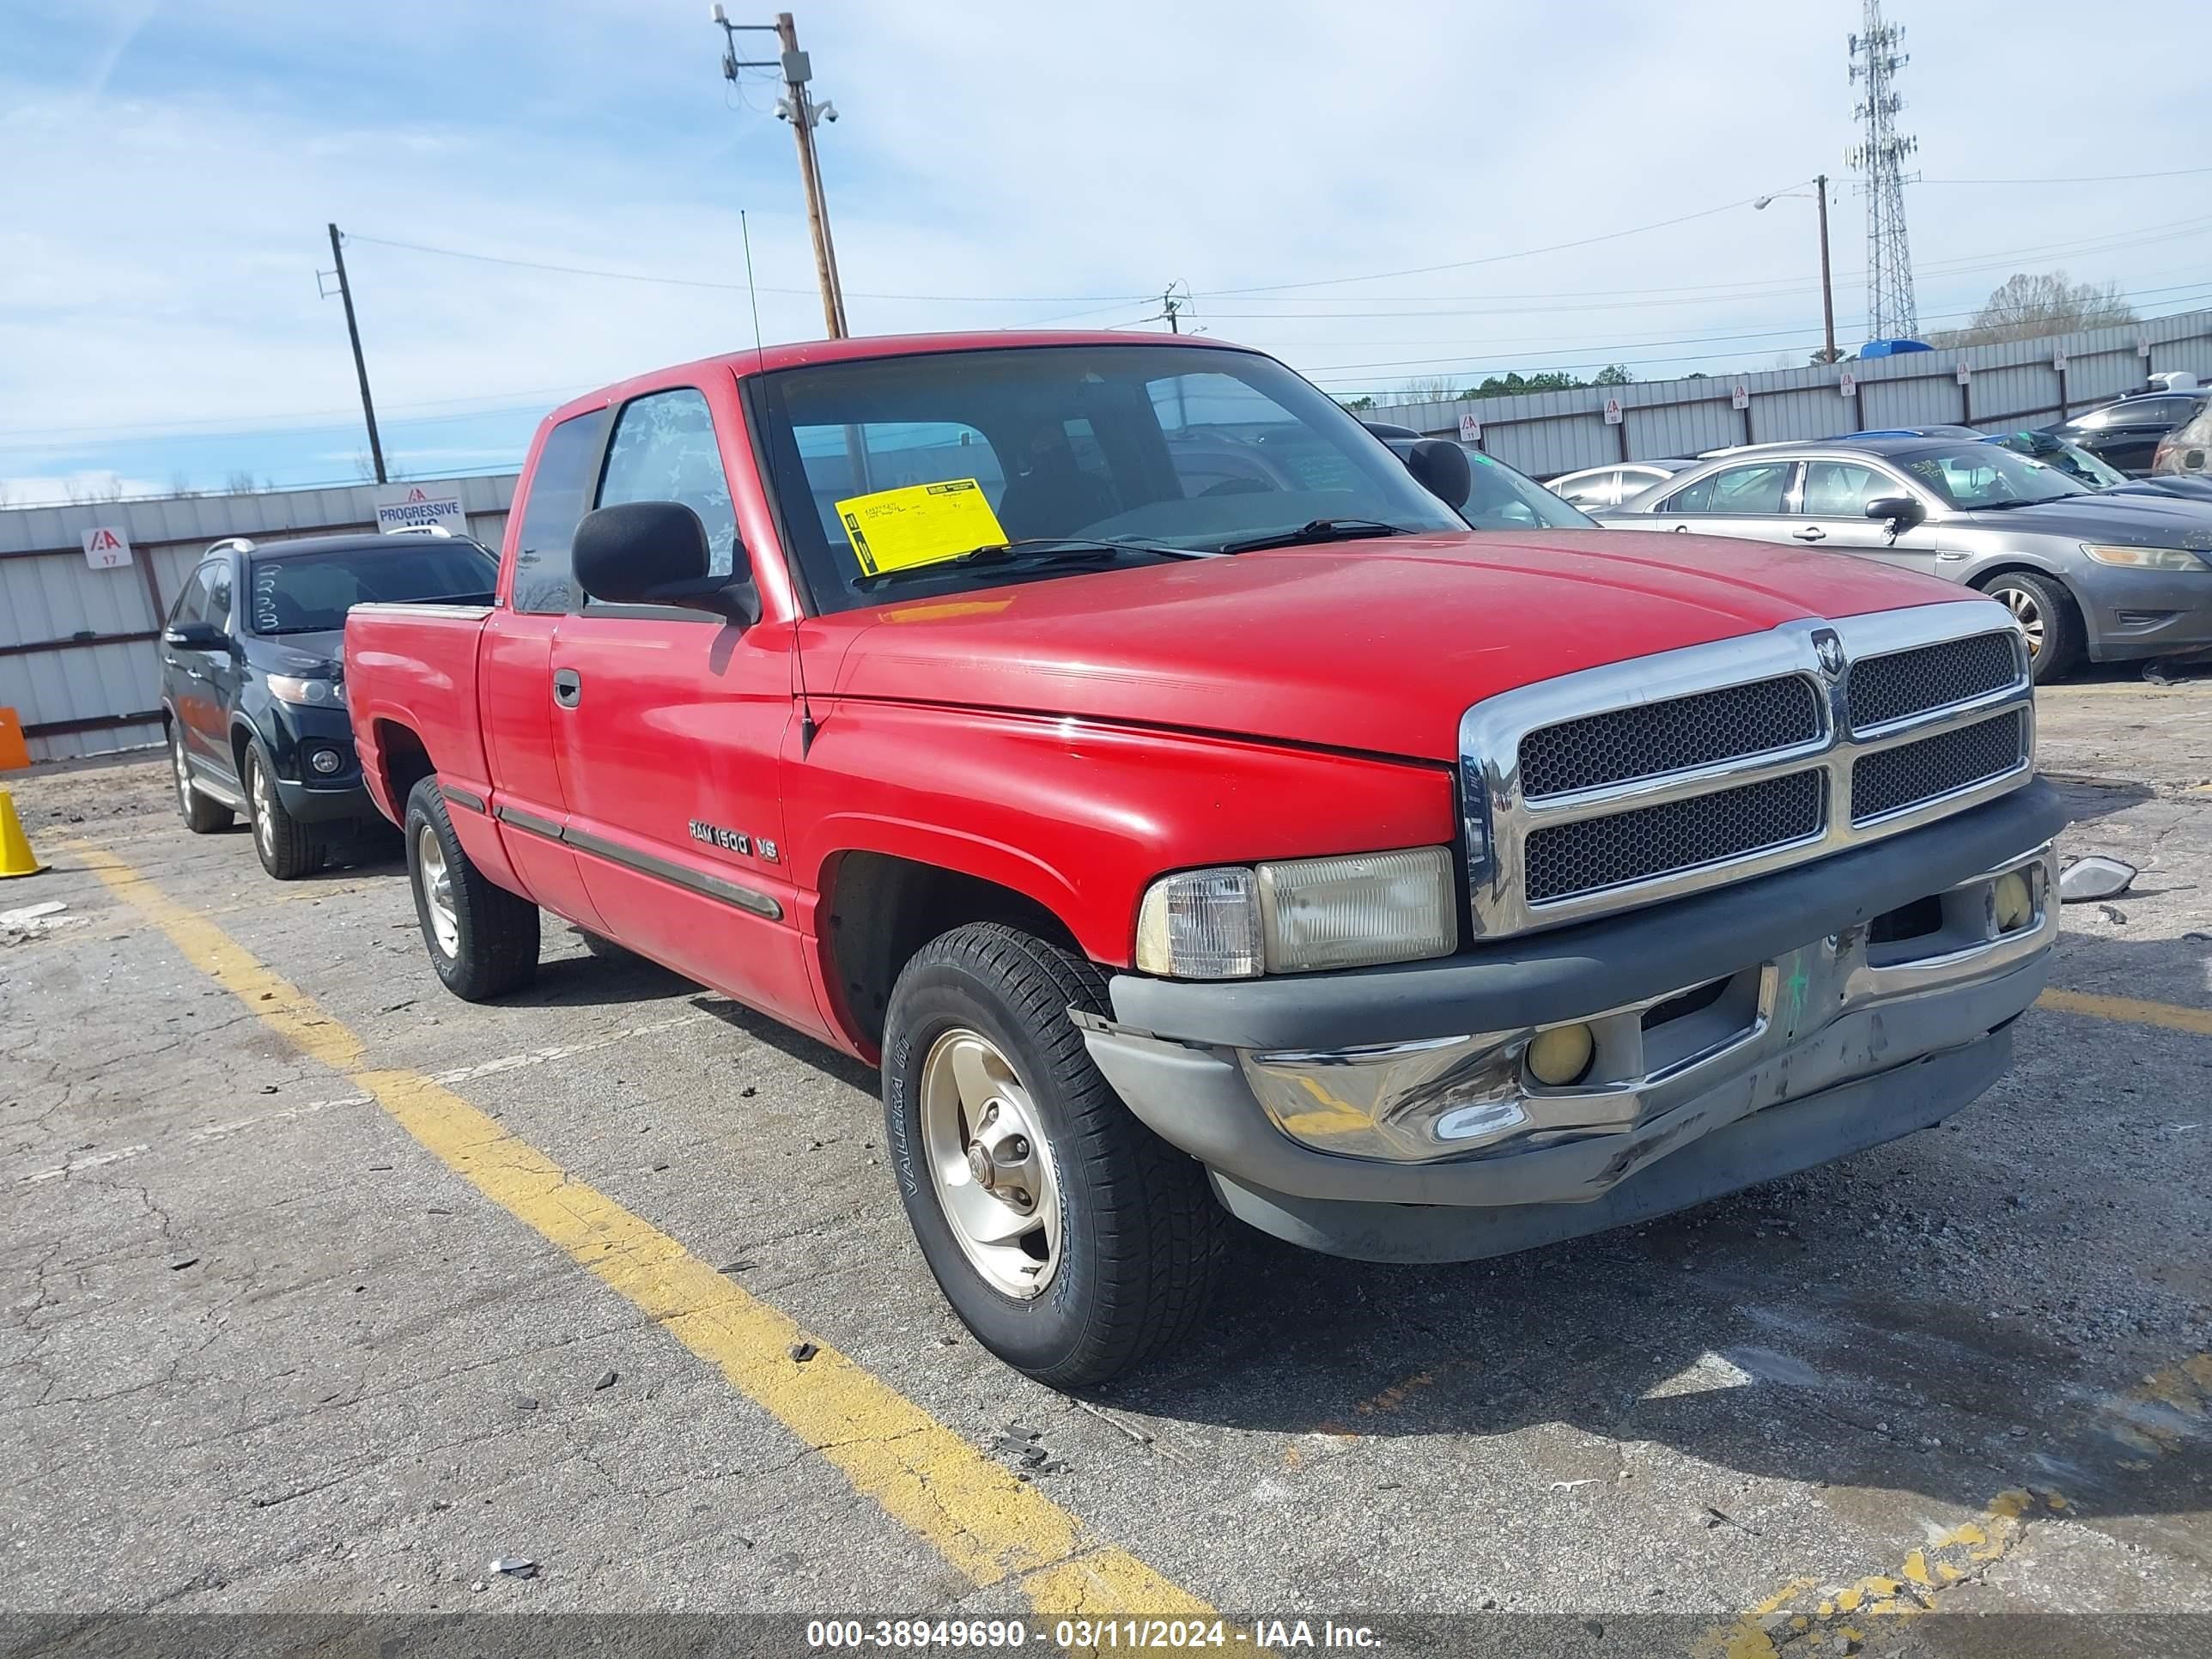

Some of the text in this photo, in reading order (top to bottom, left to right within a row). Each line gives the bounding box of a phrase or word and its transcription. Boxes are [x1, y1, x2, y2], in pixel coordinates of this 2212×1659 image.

[380, 501, 459, 522] PROGRESSIVE
[103, 555, 118, 564] 17
[689, 820, 715, 845] RAM
[715, 828, 752, 857] 1500
[892, 1030, 918, 1197] VALERA HT
